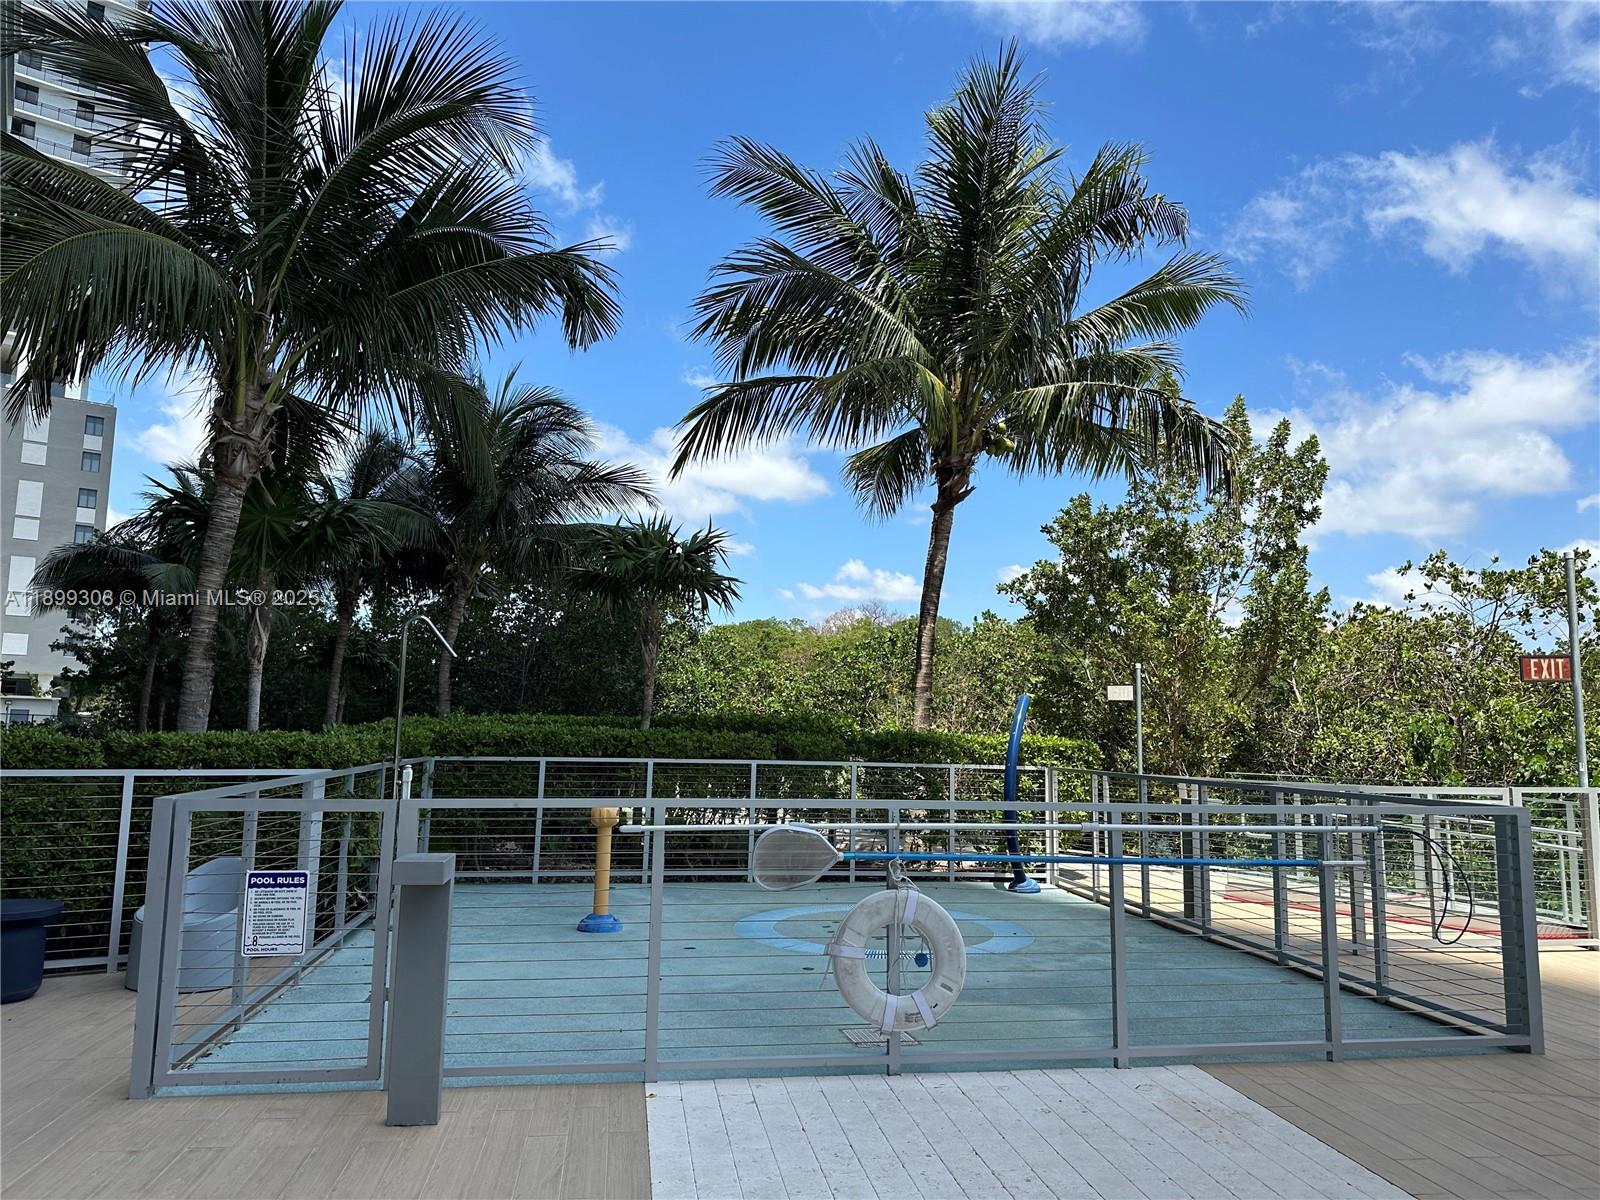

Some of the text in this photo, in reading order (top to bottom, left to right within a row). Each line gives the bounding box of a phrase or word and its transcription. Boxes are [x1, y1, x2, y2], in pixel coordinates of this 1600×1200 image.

[1530, 658, 1564, 679] EXIT
[276, 876, 305, 884] RULES
[252, 935, 257, 946] 8
